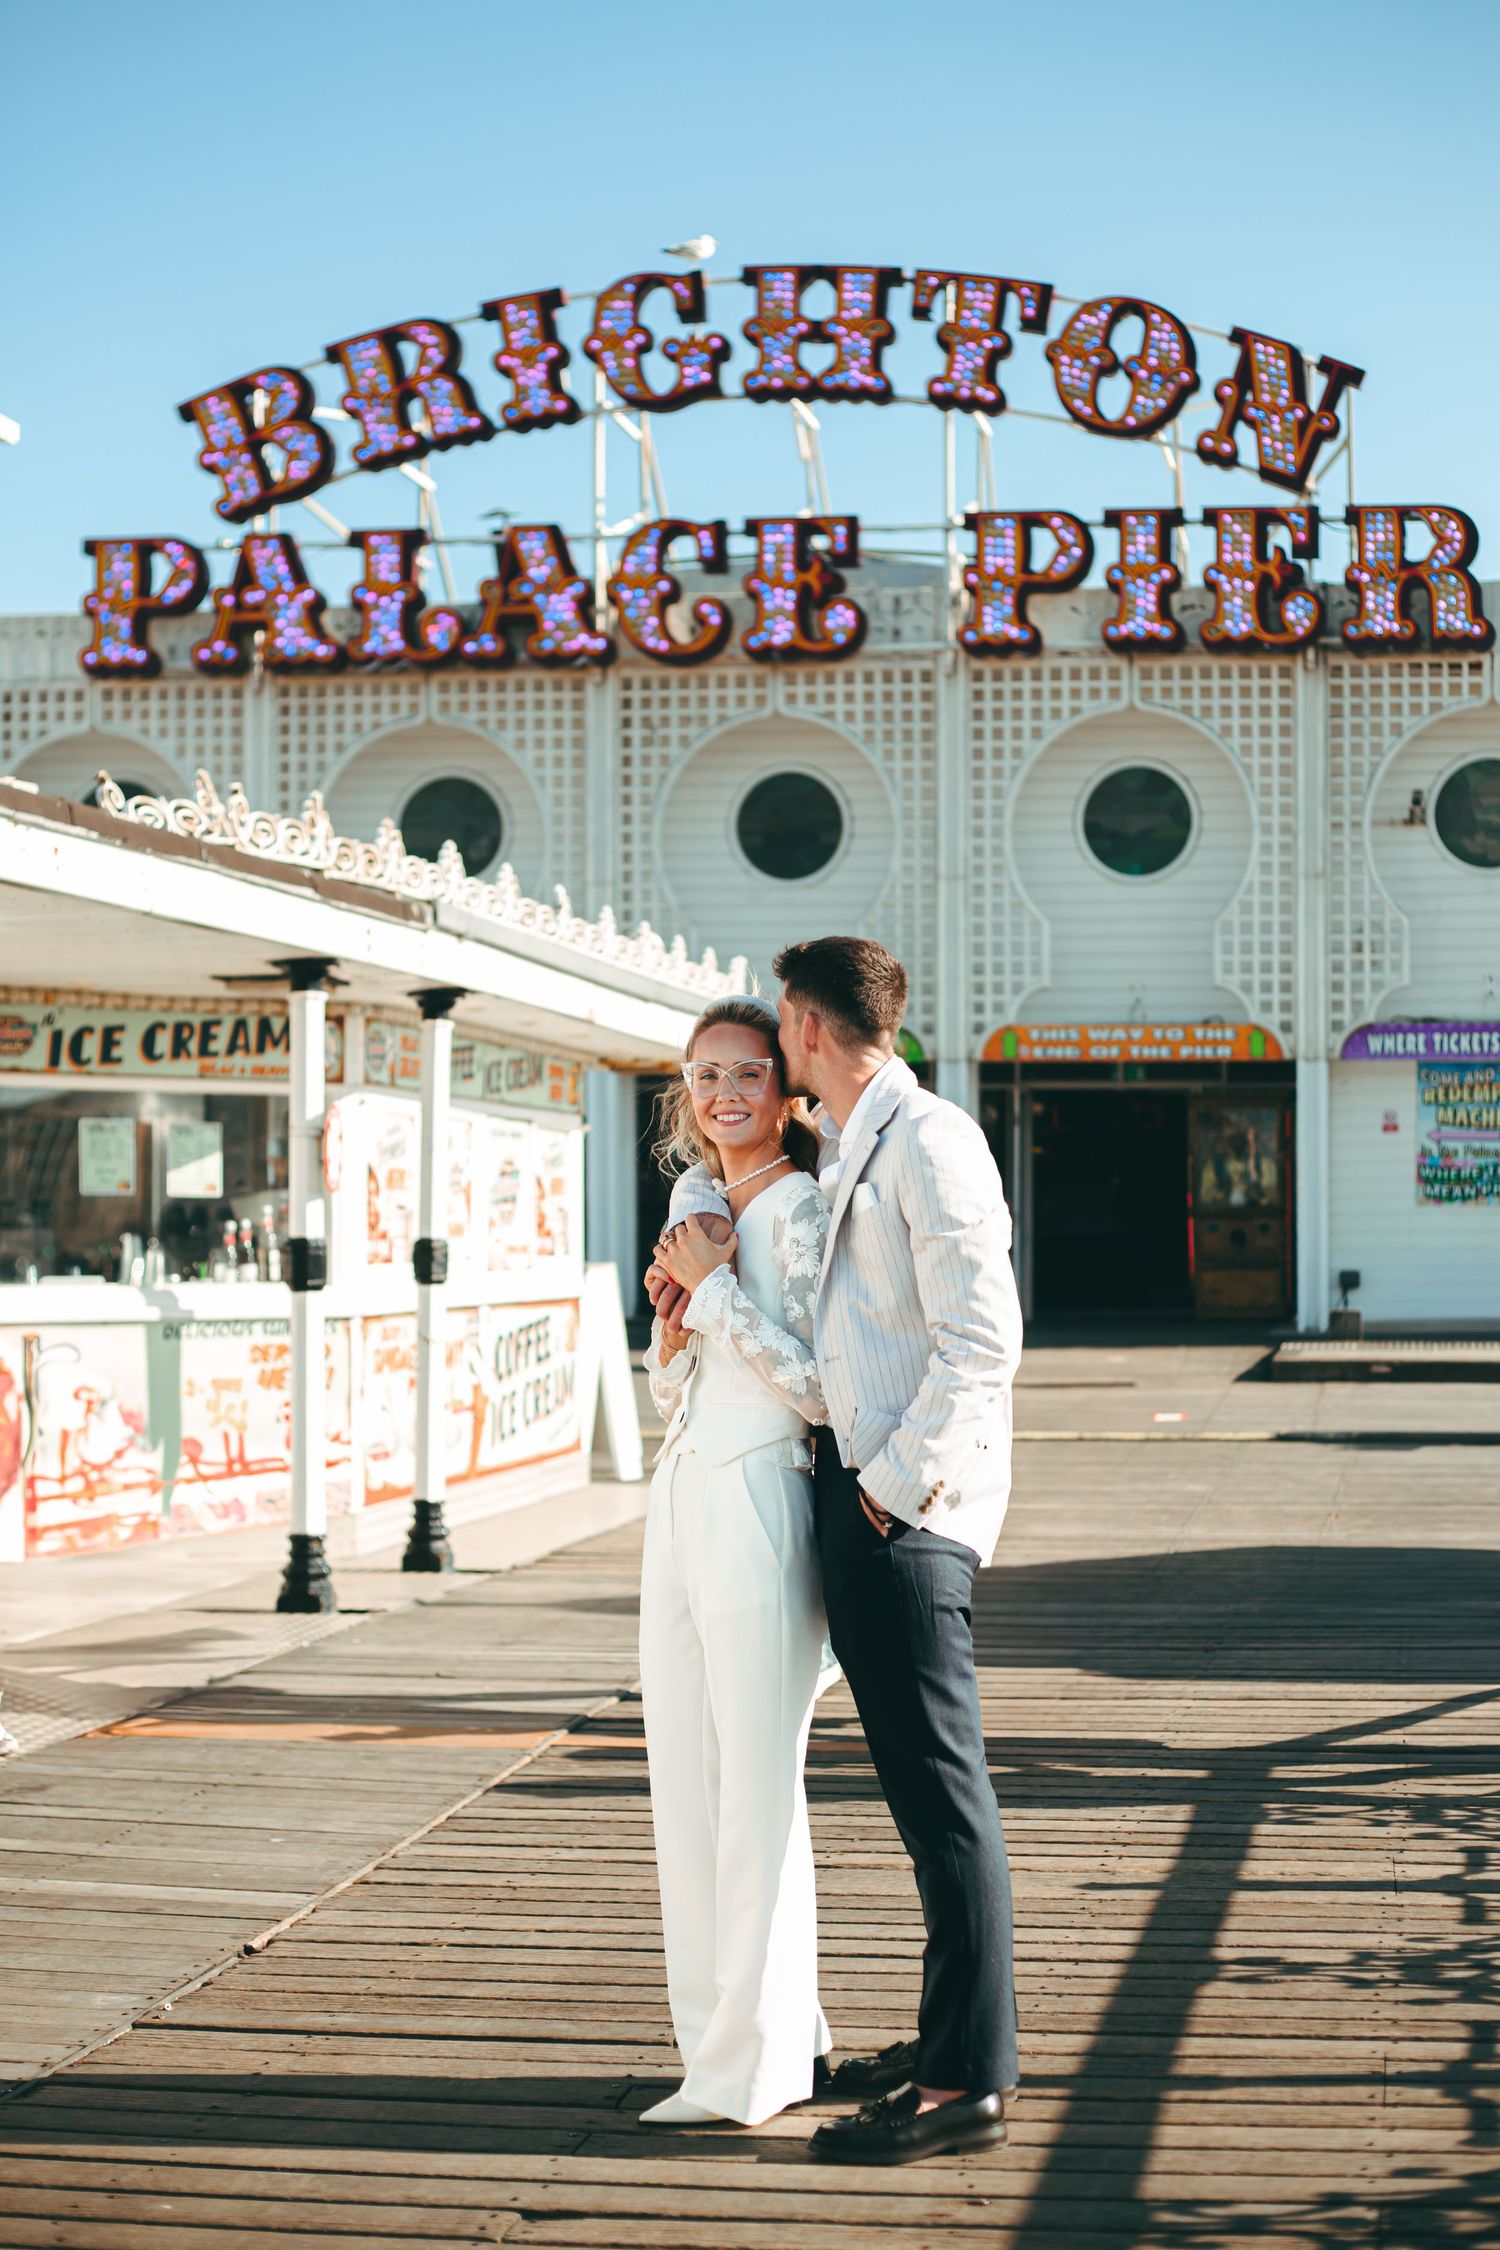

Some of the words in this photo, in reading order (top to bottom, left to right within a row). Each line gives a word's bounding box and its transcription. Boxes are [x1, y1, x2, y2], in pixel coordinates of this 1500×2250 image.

[177, 264, 1365, 523] BRIGHTON
[80, 514, 868, 679] PALACE
[960, 505, 1496, 654] PIER
[45, 1025, 125, 1073] ICE
[139, 1015, 290, 1063] CREAM
[1029, 1028, 1080, 1041] THIS
[1087, 1028, 1144, 1041] WAY
[1152, 1028, 1186, 1041] TO
[1193, 1028, 1237, 1041] THE
[1032, 1045, 1082, 1059] END
[1088, 1045, 1121, 1059] OF
[1129, 1045, 1172, 1059] THE
[1179, 1045, 1232, 1059] PIER
[1367, 1033, 1426, 1055] WHERE
[1432, 1032, 1500, 1055] TICKETS
[1420, 1068, 1461, 1087] COME
[1464, 1067, 1496, 1084] AND
[494, 1315, 550, 1383] COFFEE
